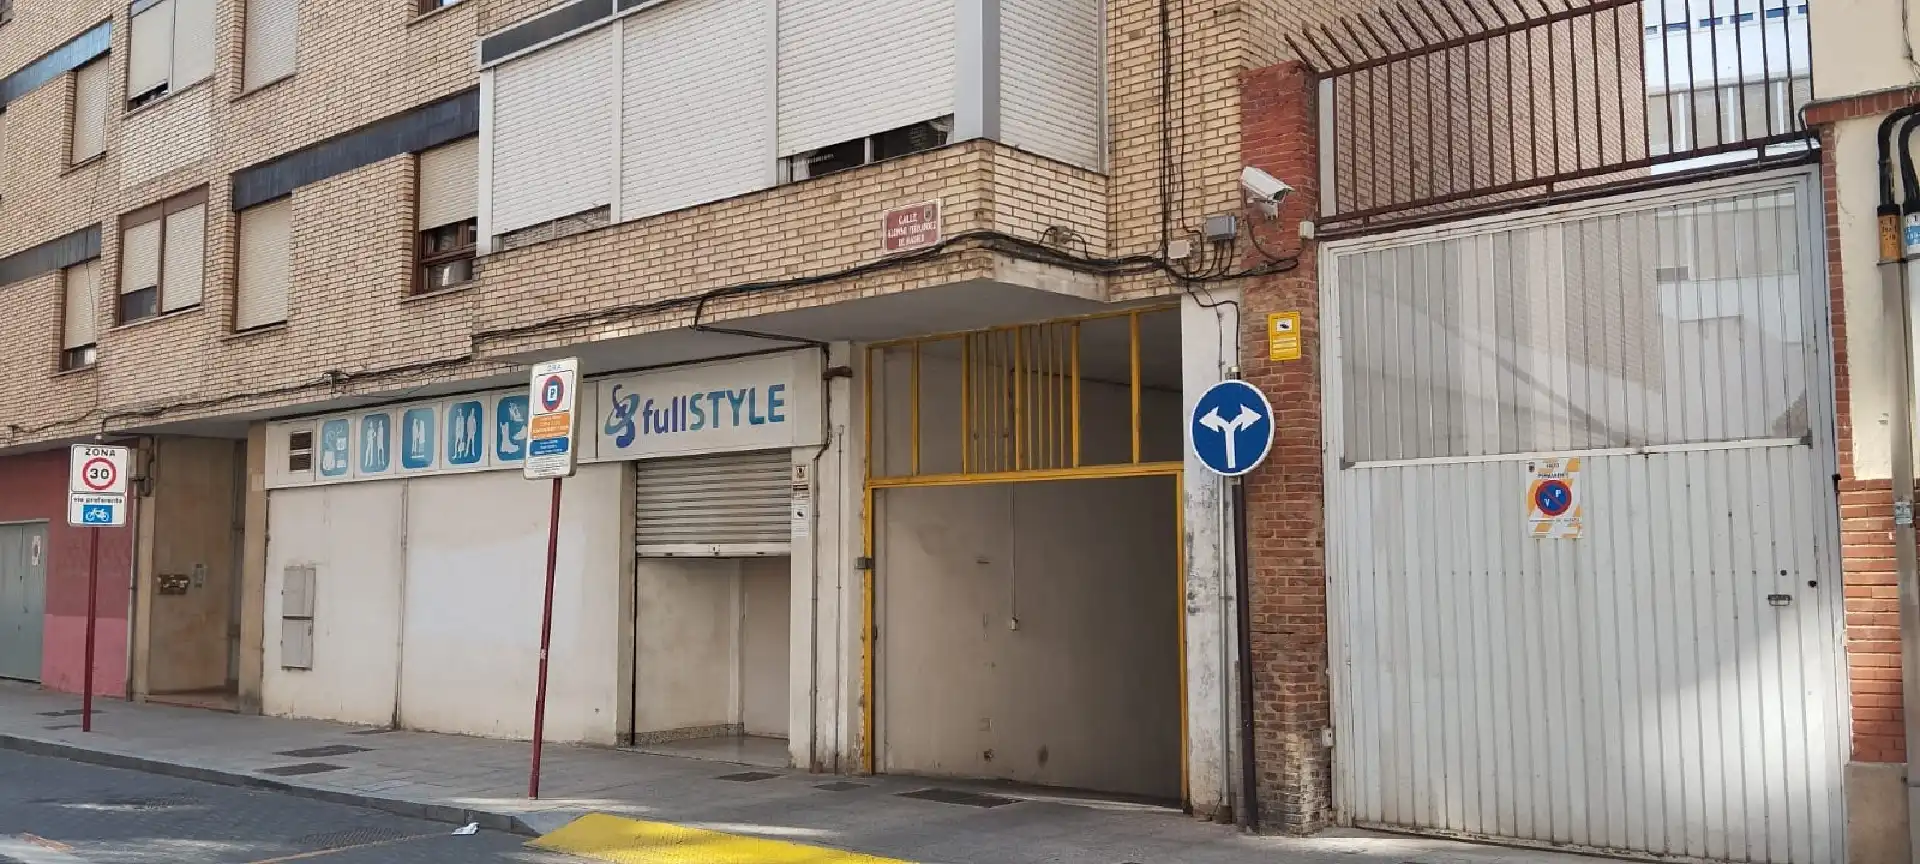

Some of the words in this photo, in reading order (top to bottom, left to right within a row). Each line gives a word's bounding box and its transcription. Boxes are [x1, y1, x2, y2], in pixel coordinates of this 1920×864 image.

[898, 212, 918, 225] CALLE
[642, 383, 786, 435] fullSTYLE
[85, 448, 116, 457] ZONA
[89, 468, 110, 480] 30
[1555, 489, 1562, 498] P
[1544, 498, 1550, 507] V
